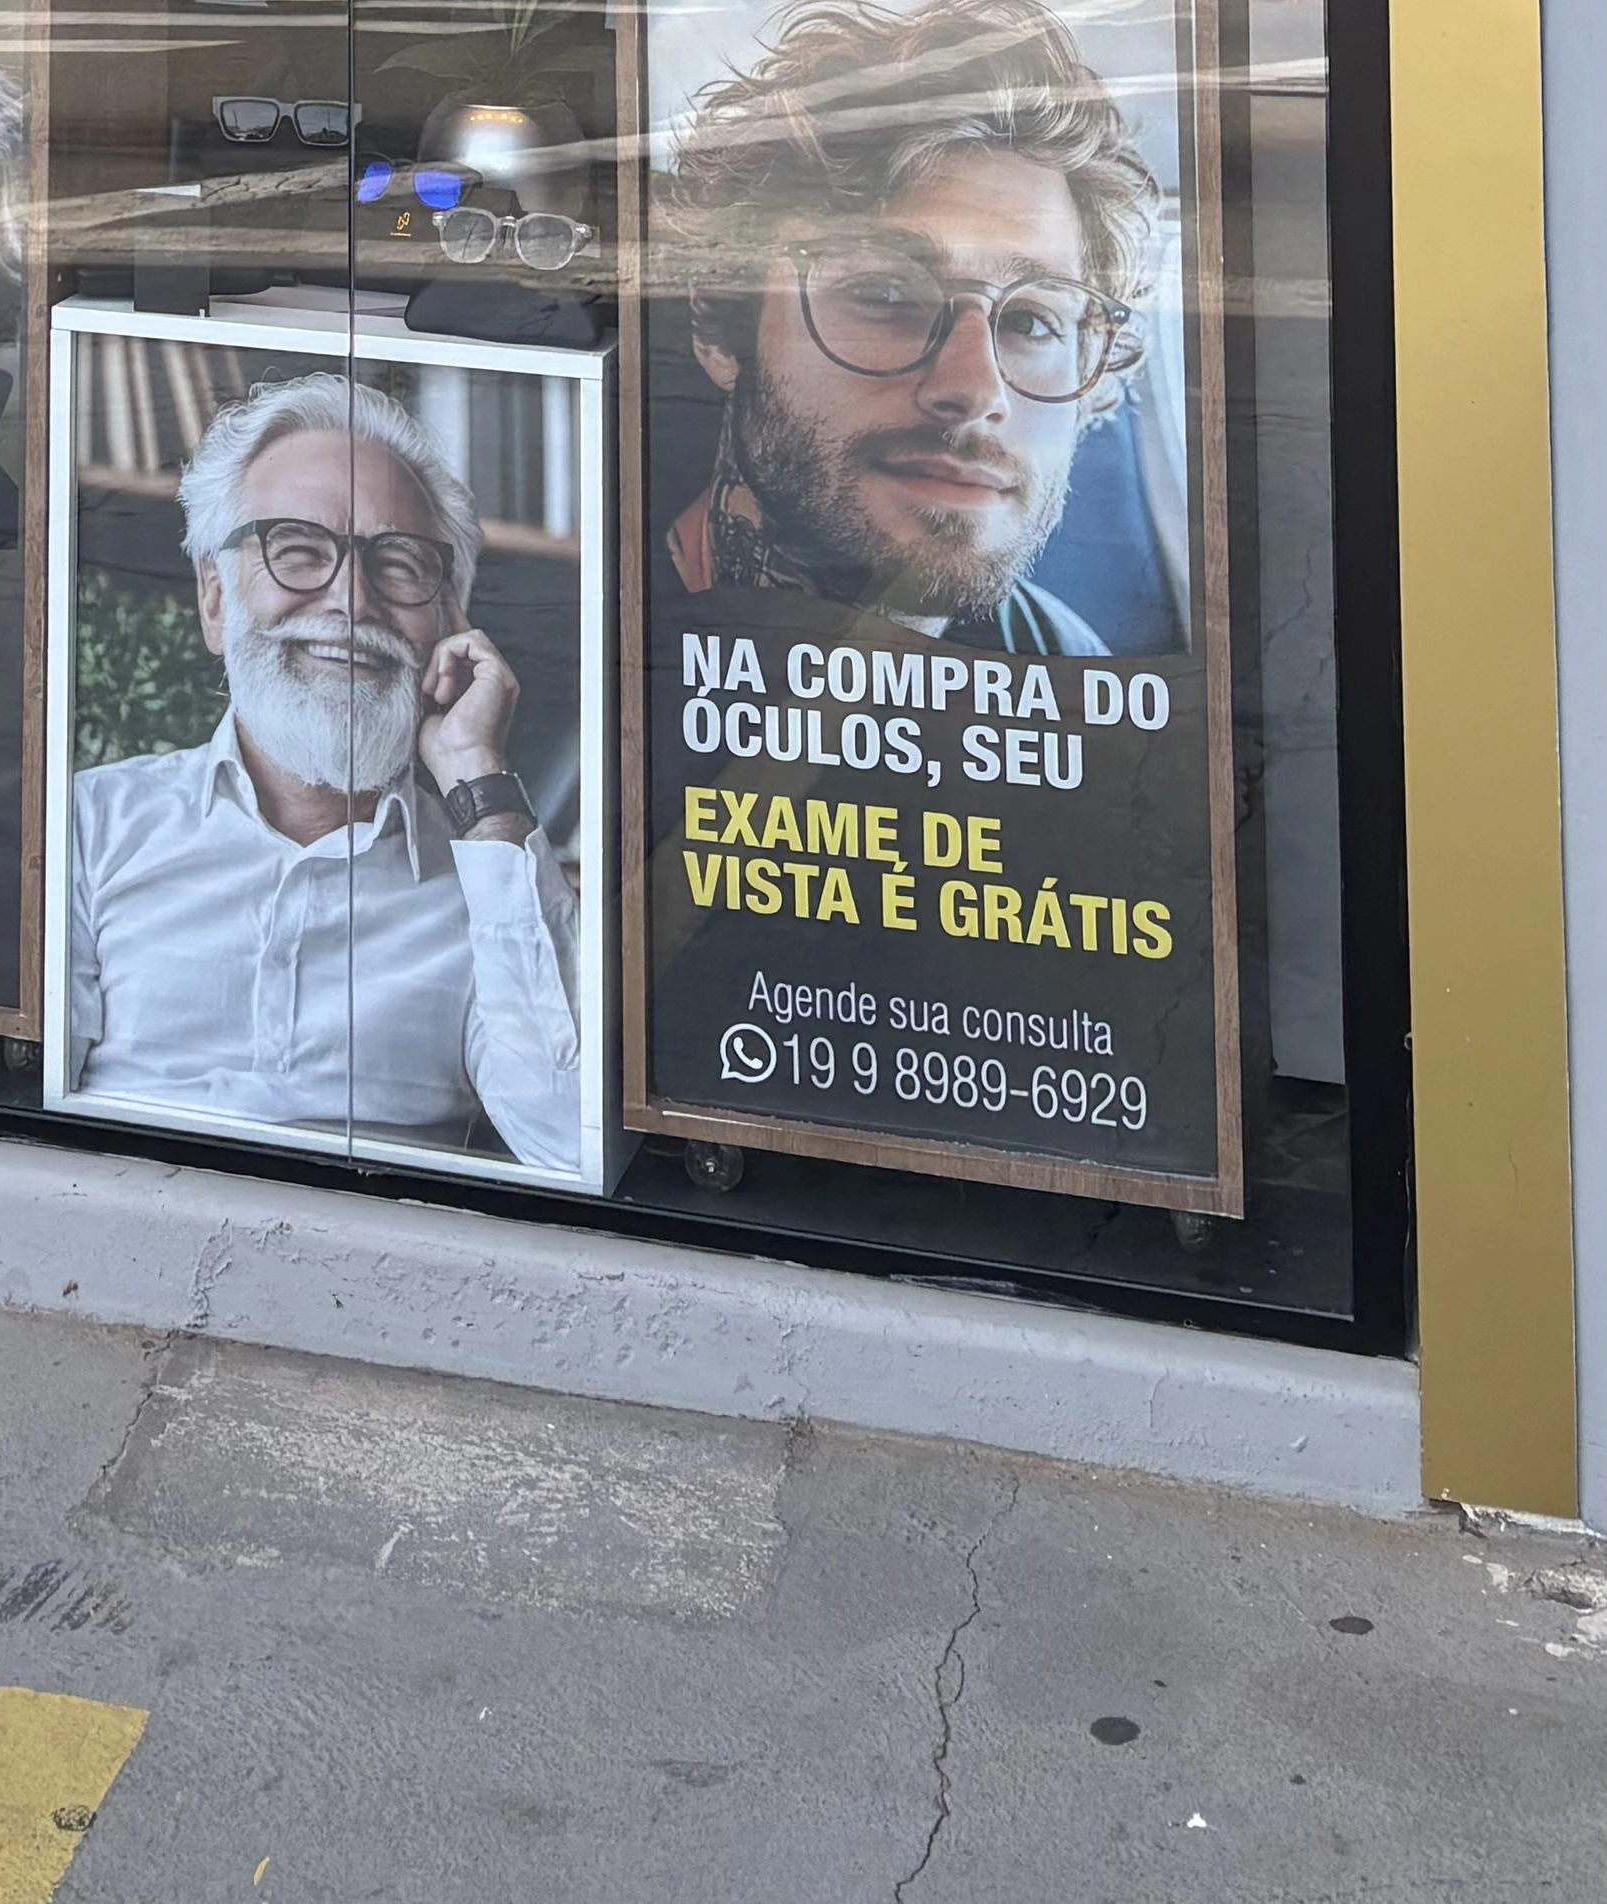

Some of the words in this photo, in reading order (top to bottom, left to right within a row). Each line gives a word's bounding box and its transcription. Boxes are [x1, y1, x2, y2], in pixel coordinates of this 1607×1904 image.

[682, 633, 766, 693] NA
[787, 643, 1060, 722] COMPRA
[1084, 669, 1170, 731] DO
[682, 687, 942, 788] ÓCULOS,
[962, 724, 1084, 790] SEU
[684, 786, 900, 863] EXAME
[922, 811, 1003, 874] DE
[682, 850, 860, 925] VISTA
[882, 861, 918, 931] É
[939, 876, 1173, 960] GRÁTIS
[748, 970, 877, 1025] Agende
[890, 996, 950, 1035] sua
[963, 1005, 1114, 1056] consulta
[783, 1033, 834, 1089] 19
[852, 1041, 878, 1094] 9
[895, 1047, 1147, 1131] 8989-6929
